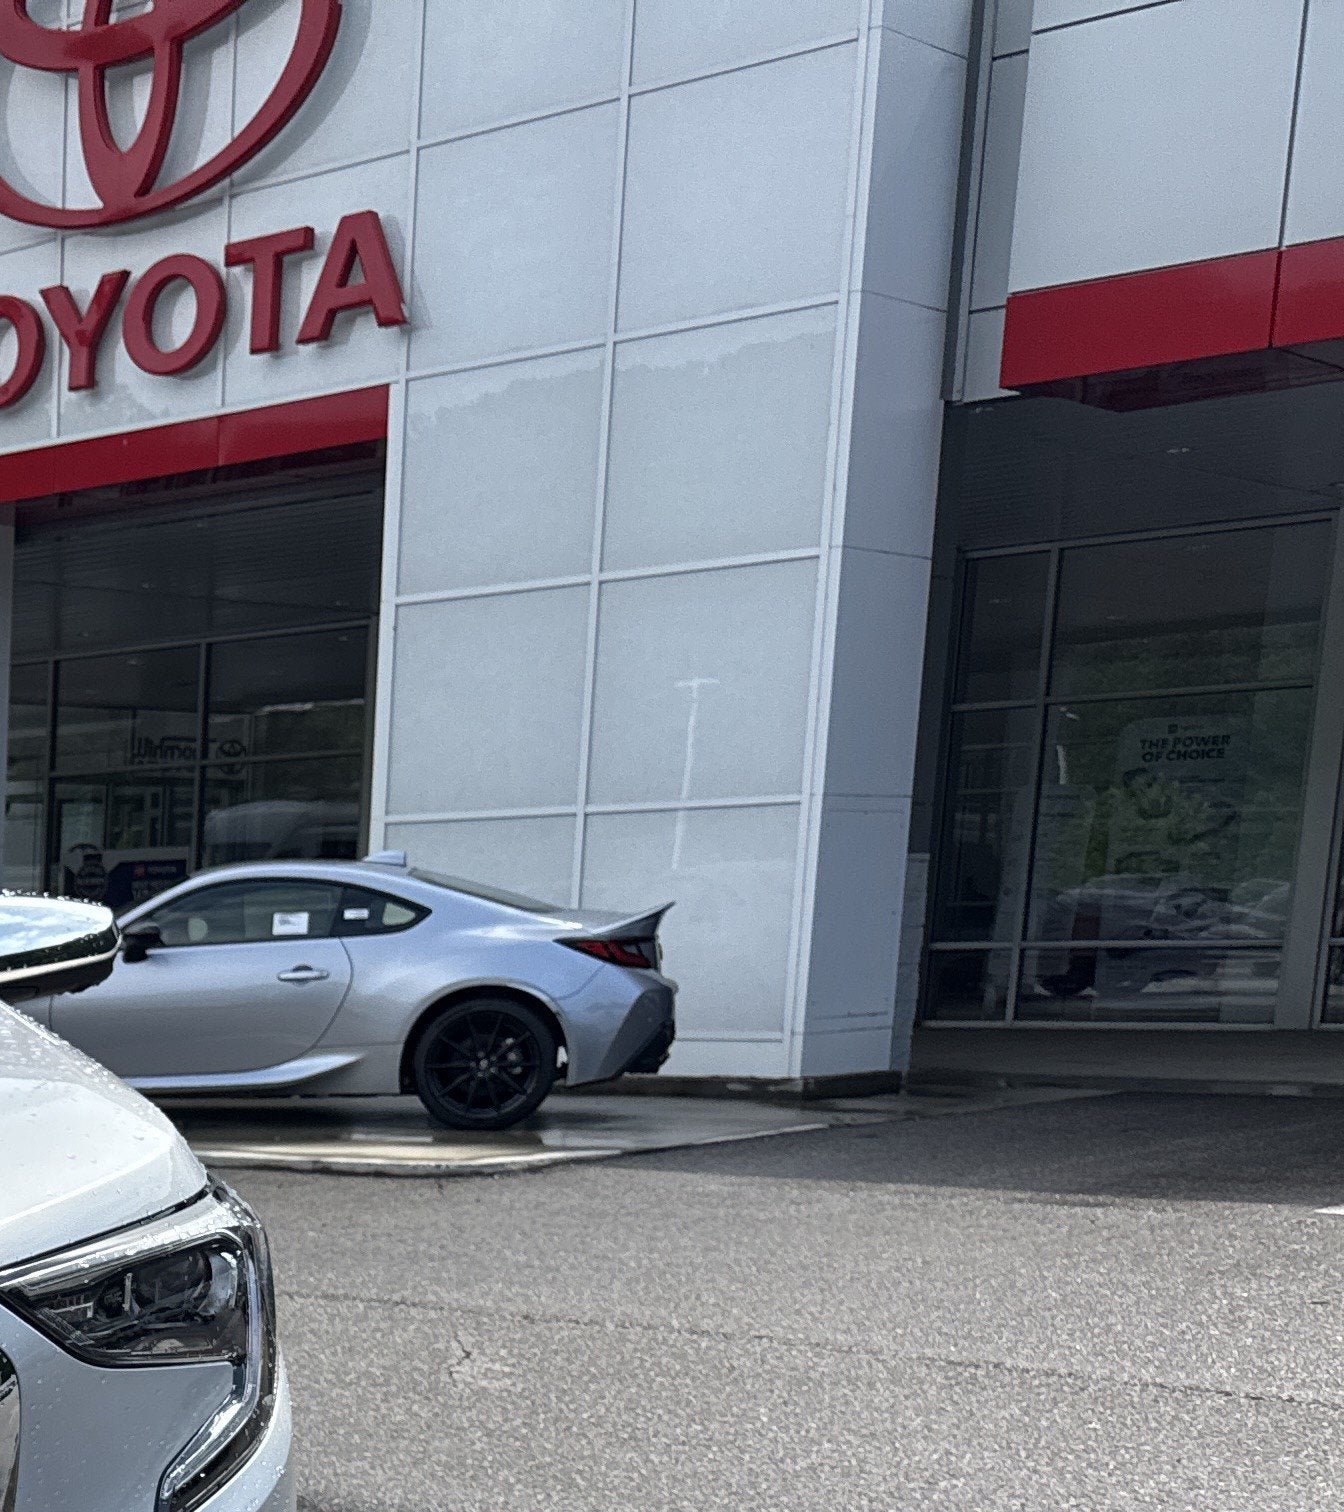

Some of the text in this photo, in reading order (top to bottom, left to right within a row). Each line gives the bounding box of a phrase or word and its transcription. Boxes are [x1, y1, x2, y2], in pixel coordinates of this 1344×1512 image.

[1140, 734, 1231, 750] THE POWER
[1142, 748, 1226, 763] OF CHOICE
